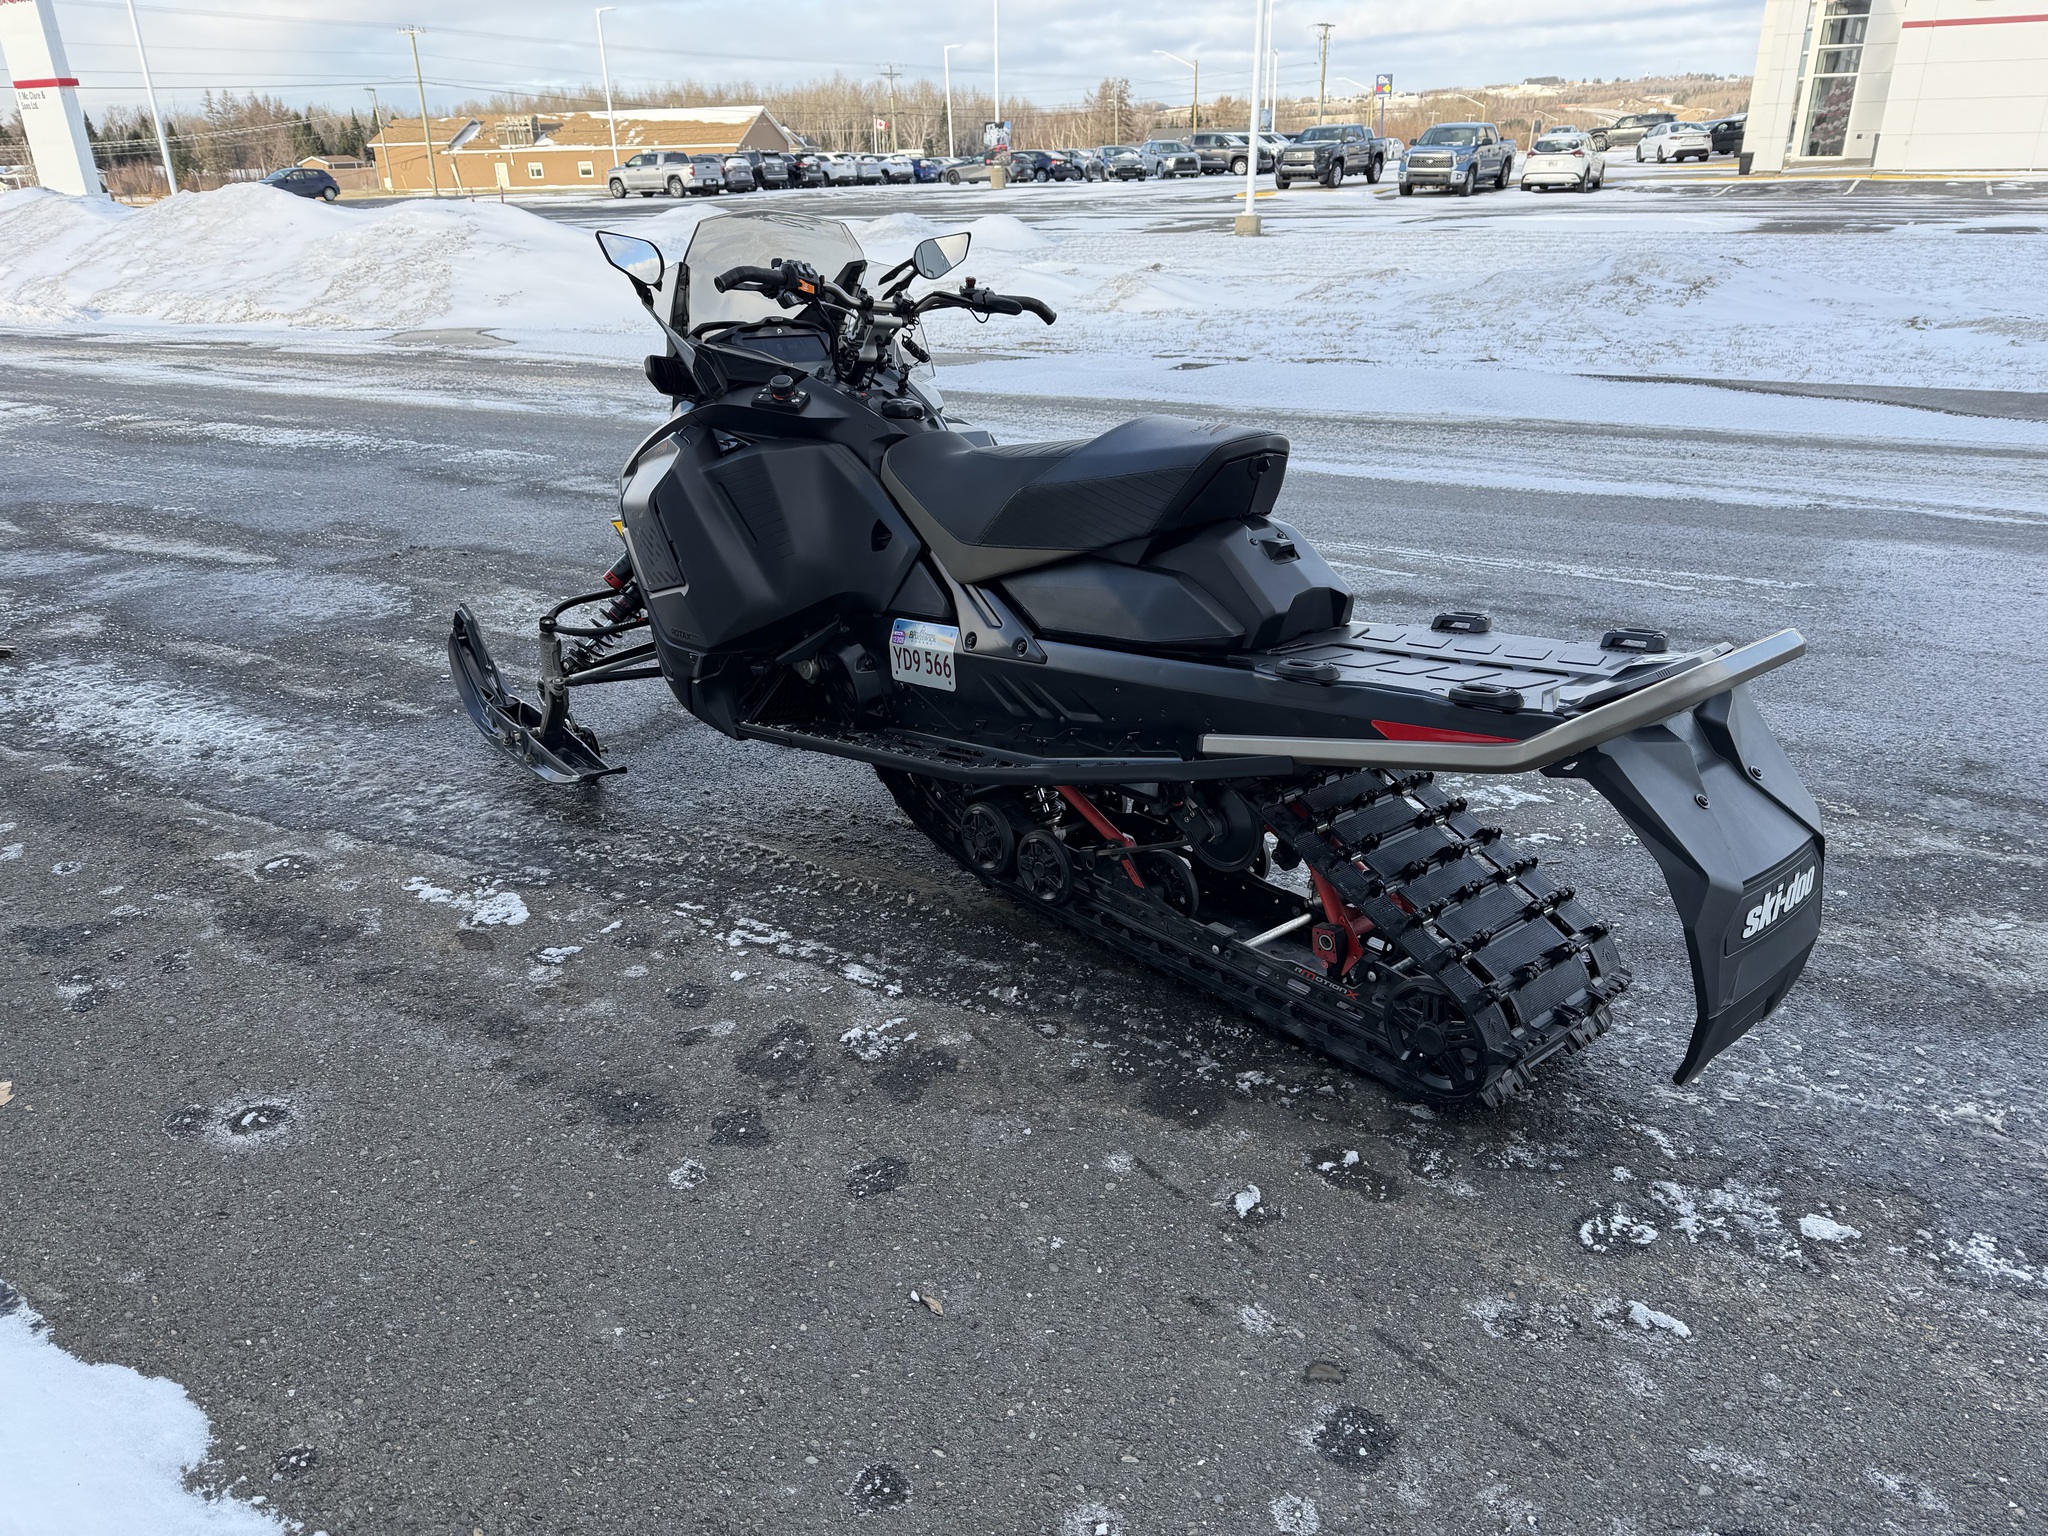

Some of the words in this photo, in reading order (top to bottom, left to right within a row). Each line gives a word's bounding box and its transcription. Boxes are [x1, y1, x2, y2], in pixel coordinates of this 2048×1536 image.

[671, 628, 691, 641] ROTAX
[893, 646, 920, 672] YD9
[925, 651, 951, 678] 566
